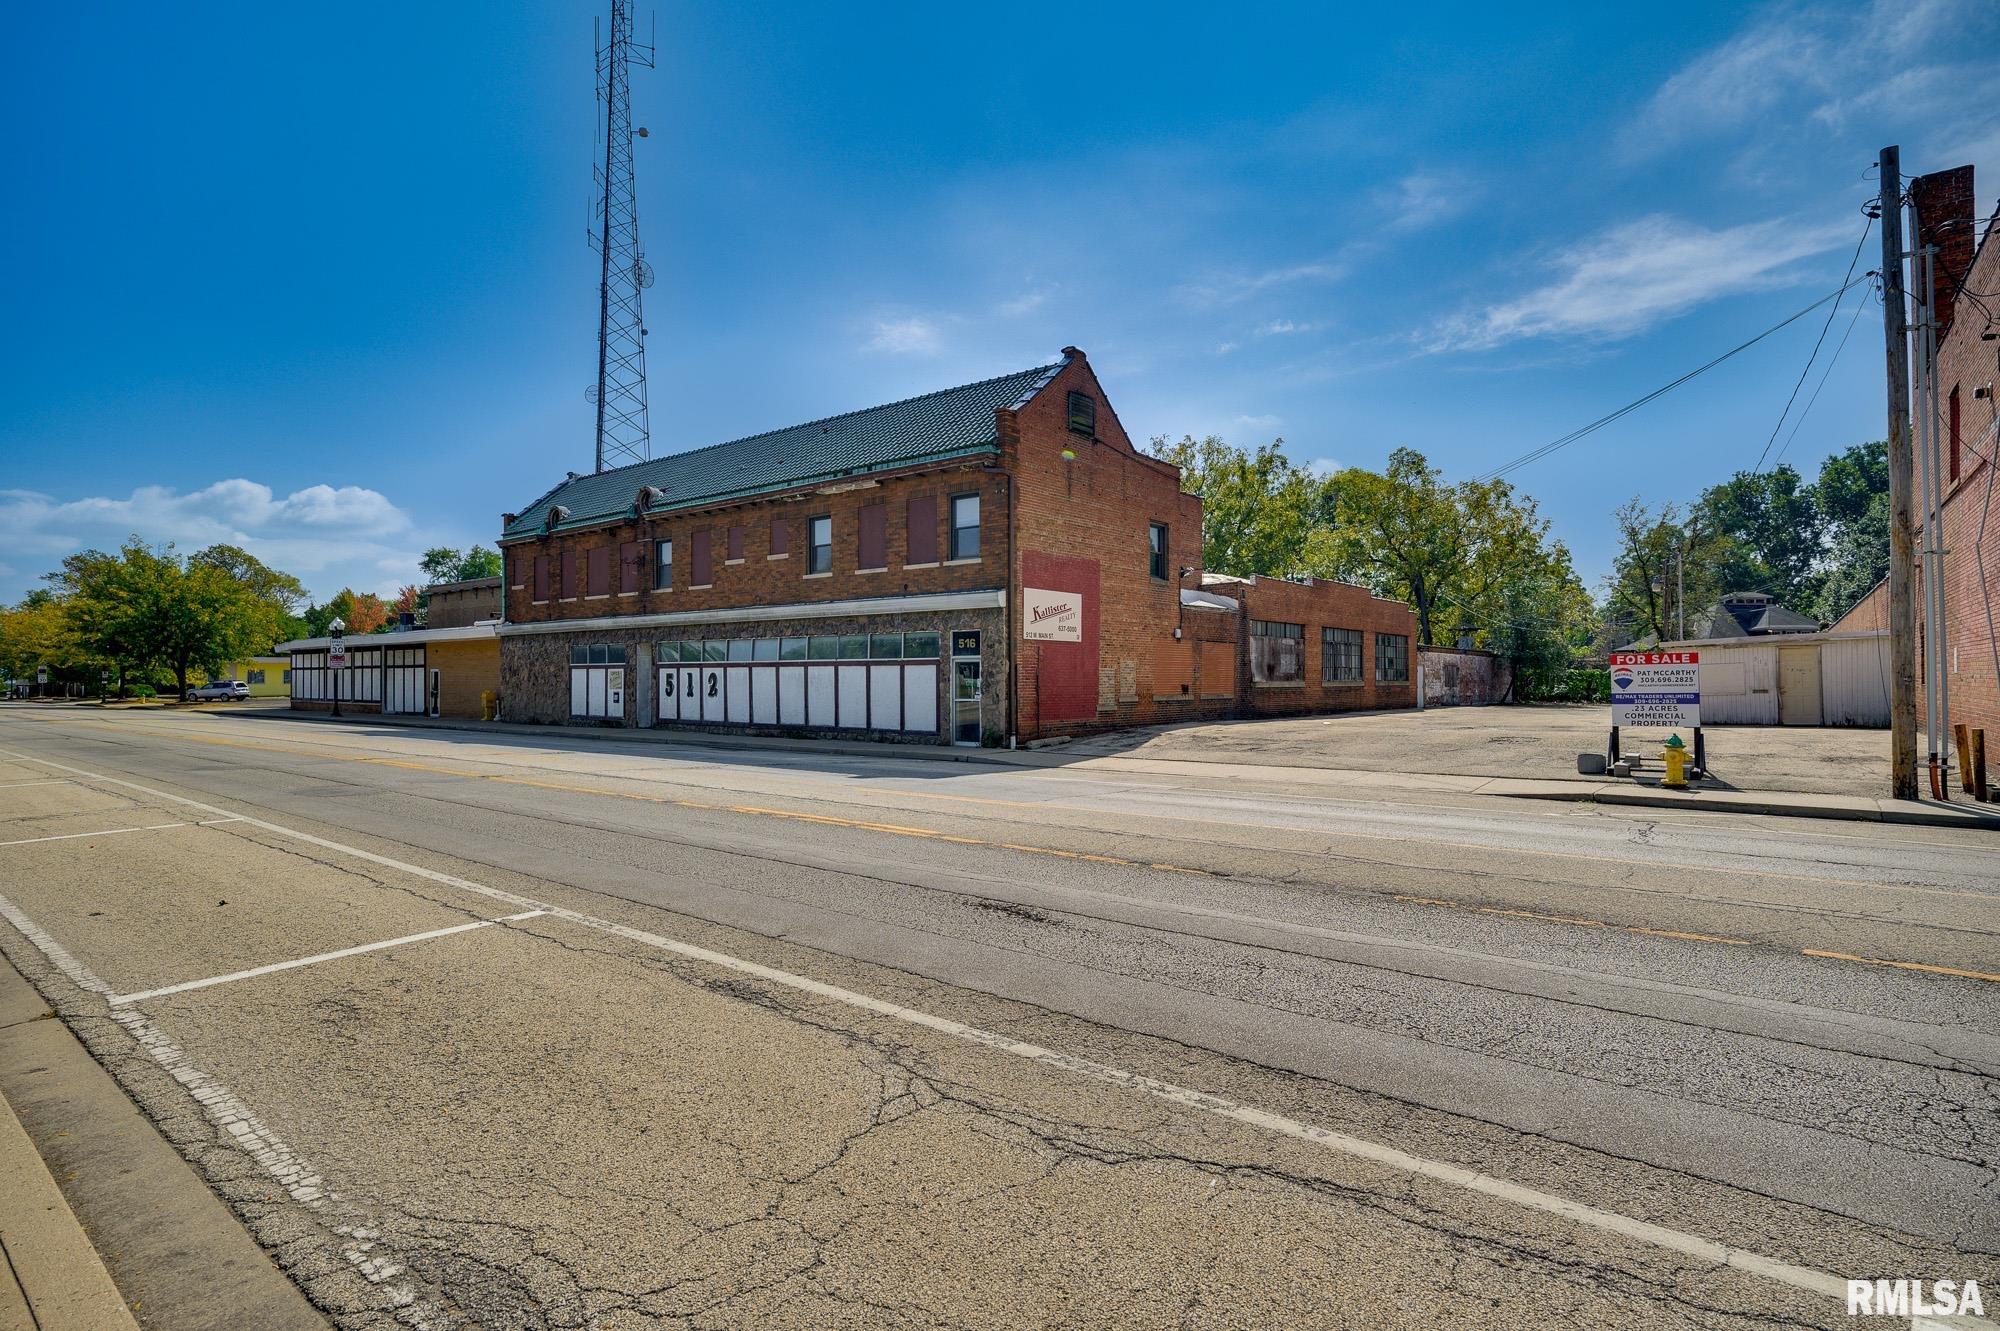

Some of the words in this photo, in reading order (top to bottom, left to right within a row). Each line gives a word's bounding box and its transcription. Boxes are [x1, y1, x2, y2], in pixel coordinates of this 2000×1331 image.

[1033, 603, 1067, 621] Kallister
[1058, 612, 1077, 623] REALTY
[958, 638, 976, 648] 516
[1616, 655, 1646, 665] FOR
[1651, 653, 1690, 664] SALE
